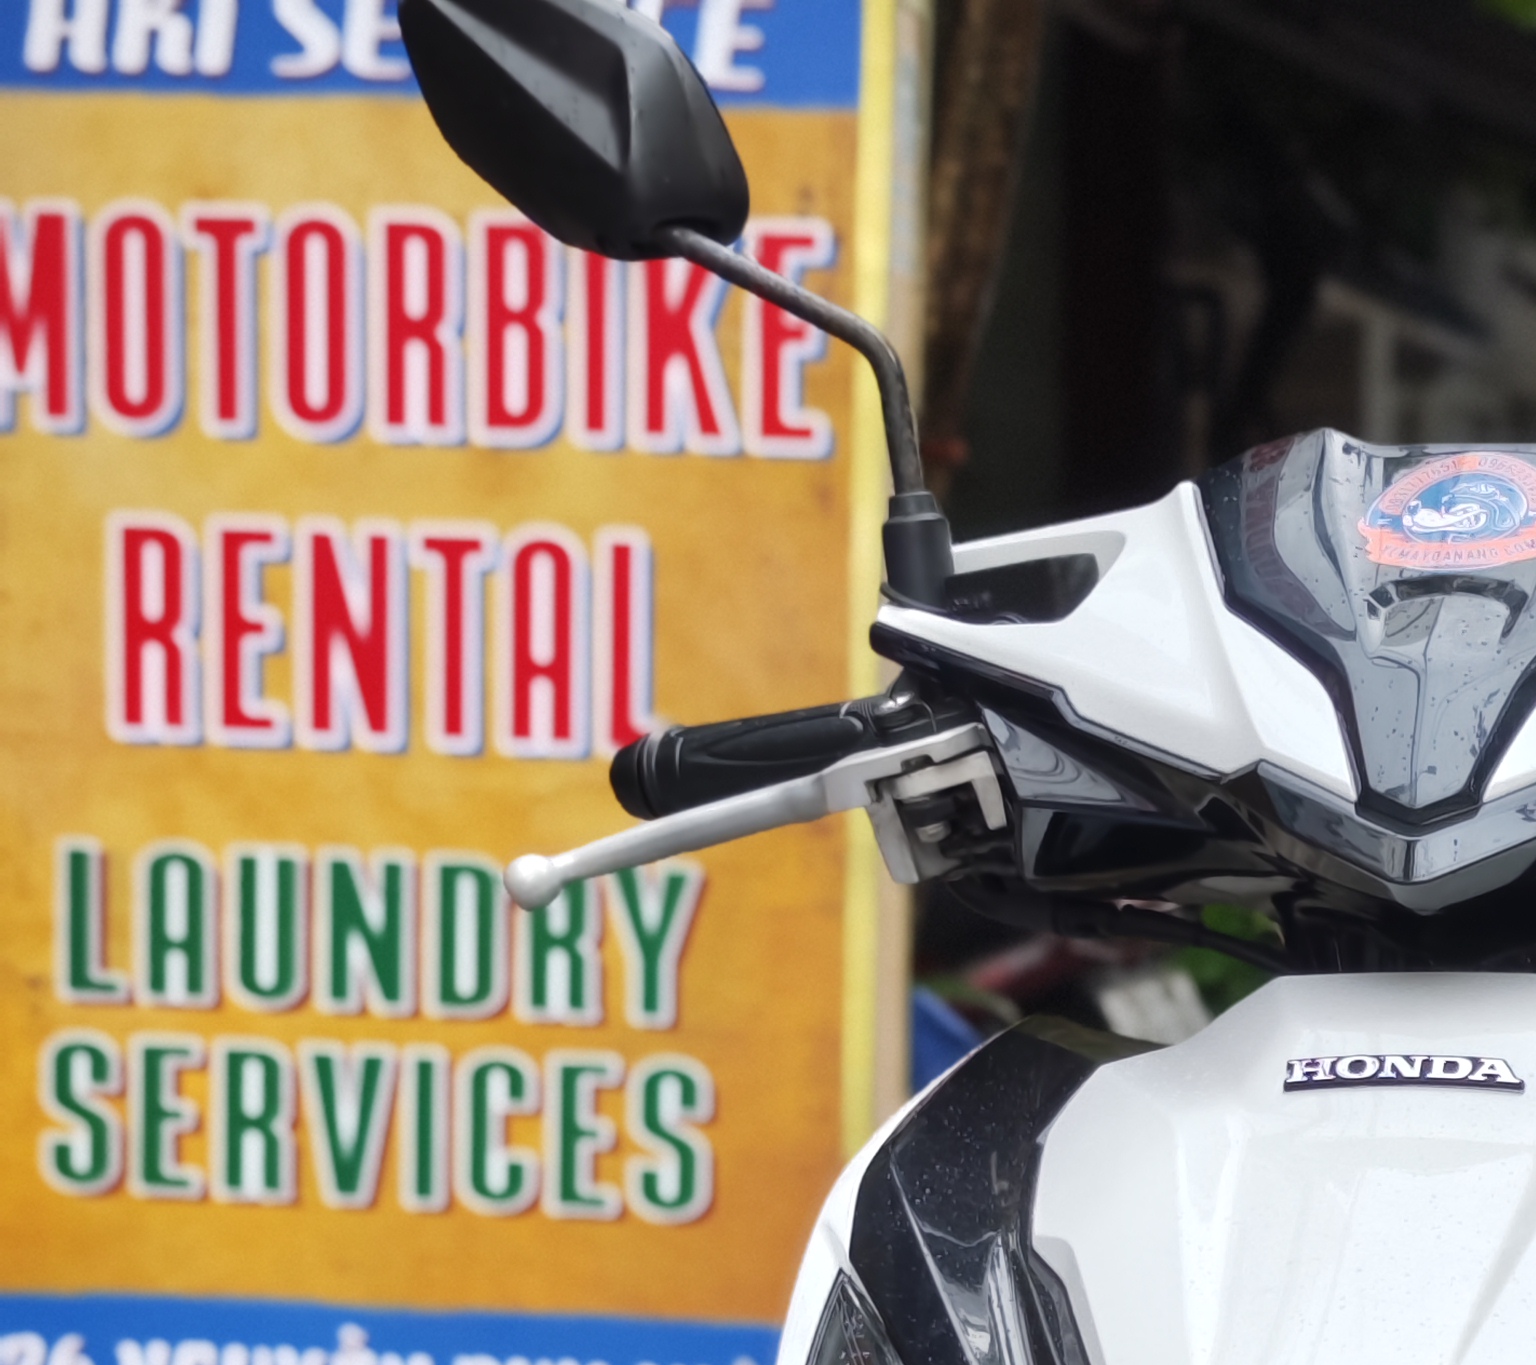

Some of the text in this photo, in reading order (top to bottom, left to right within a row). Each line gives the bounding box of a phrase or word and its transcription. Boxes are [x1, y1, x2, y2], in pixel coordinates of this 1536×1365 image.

[0, 196, 838, 460] MOTORBIKE
[106, 510, 664, 760] RENTAL
[56, 836, 706, 1028] LAUNDRY
[40, 1030, 716, 1222] SERVICES
[1284, 1055, 1521, 1085] HONDA
